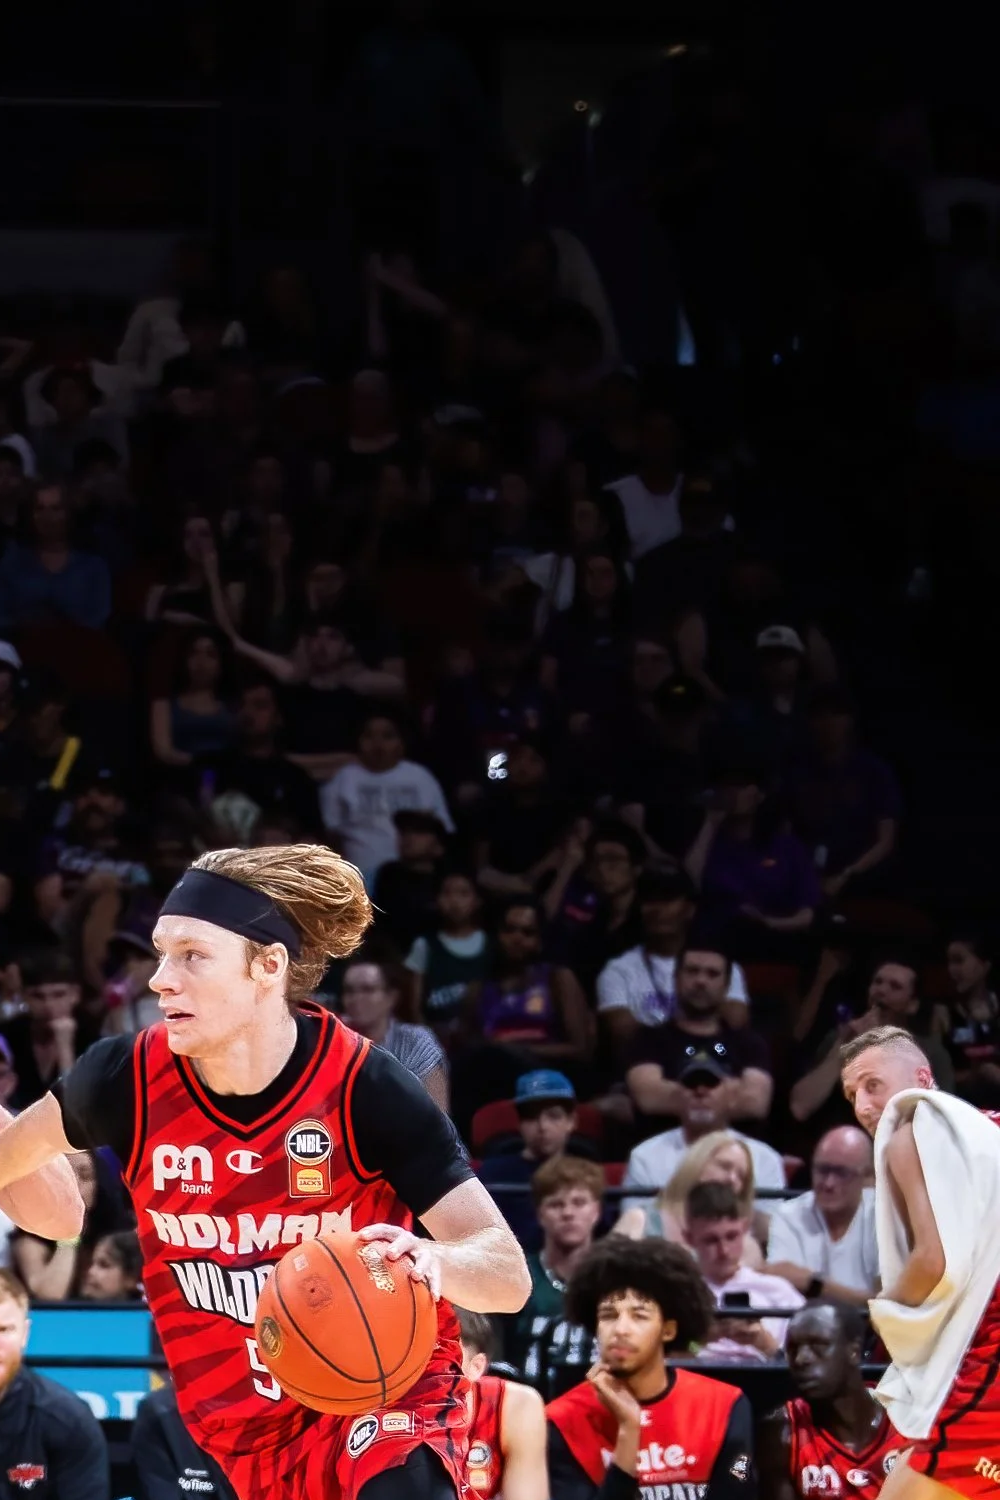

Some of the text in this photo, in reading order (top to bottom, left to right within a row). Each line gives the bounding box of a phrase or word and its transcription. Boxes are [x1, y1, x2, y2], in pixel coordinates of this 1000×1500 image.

[296, 1134, 323, 1153] NBL
[181, 1181, 213, 1194] bank
[145, 1202, 353, 1256] HOLMAN
[352, 1423, 373, 1449] NBL
